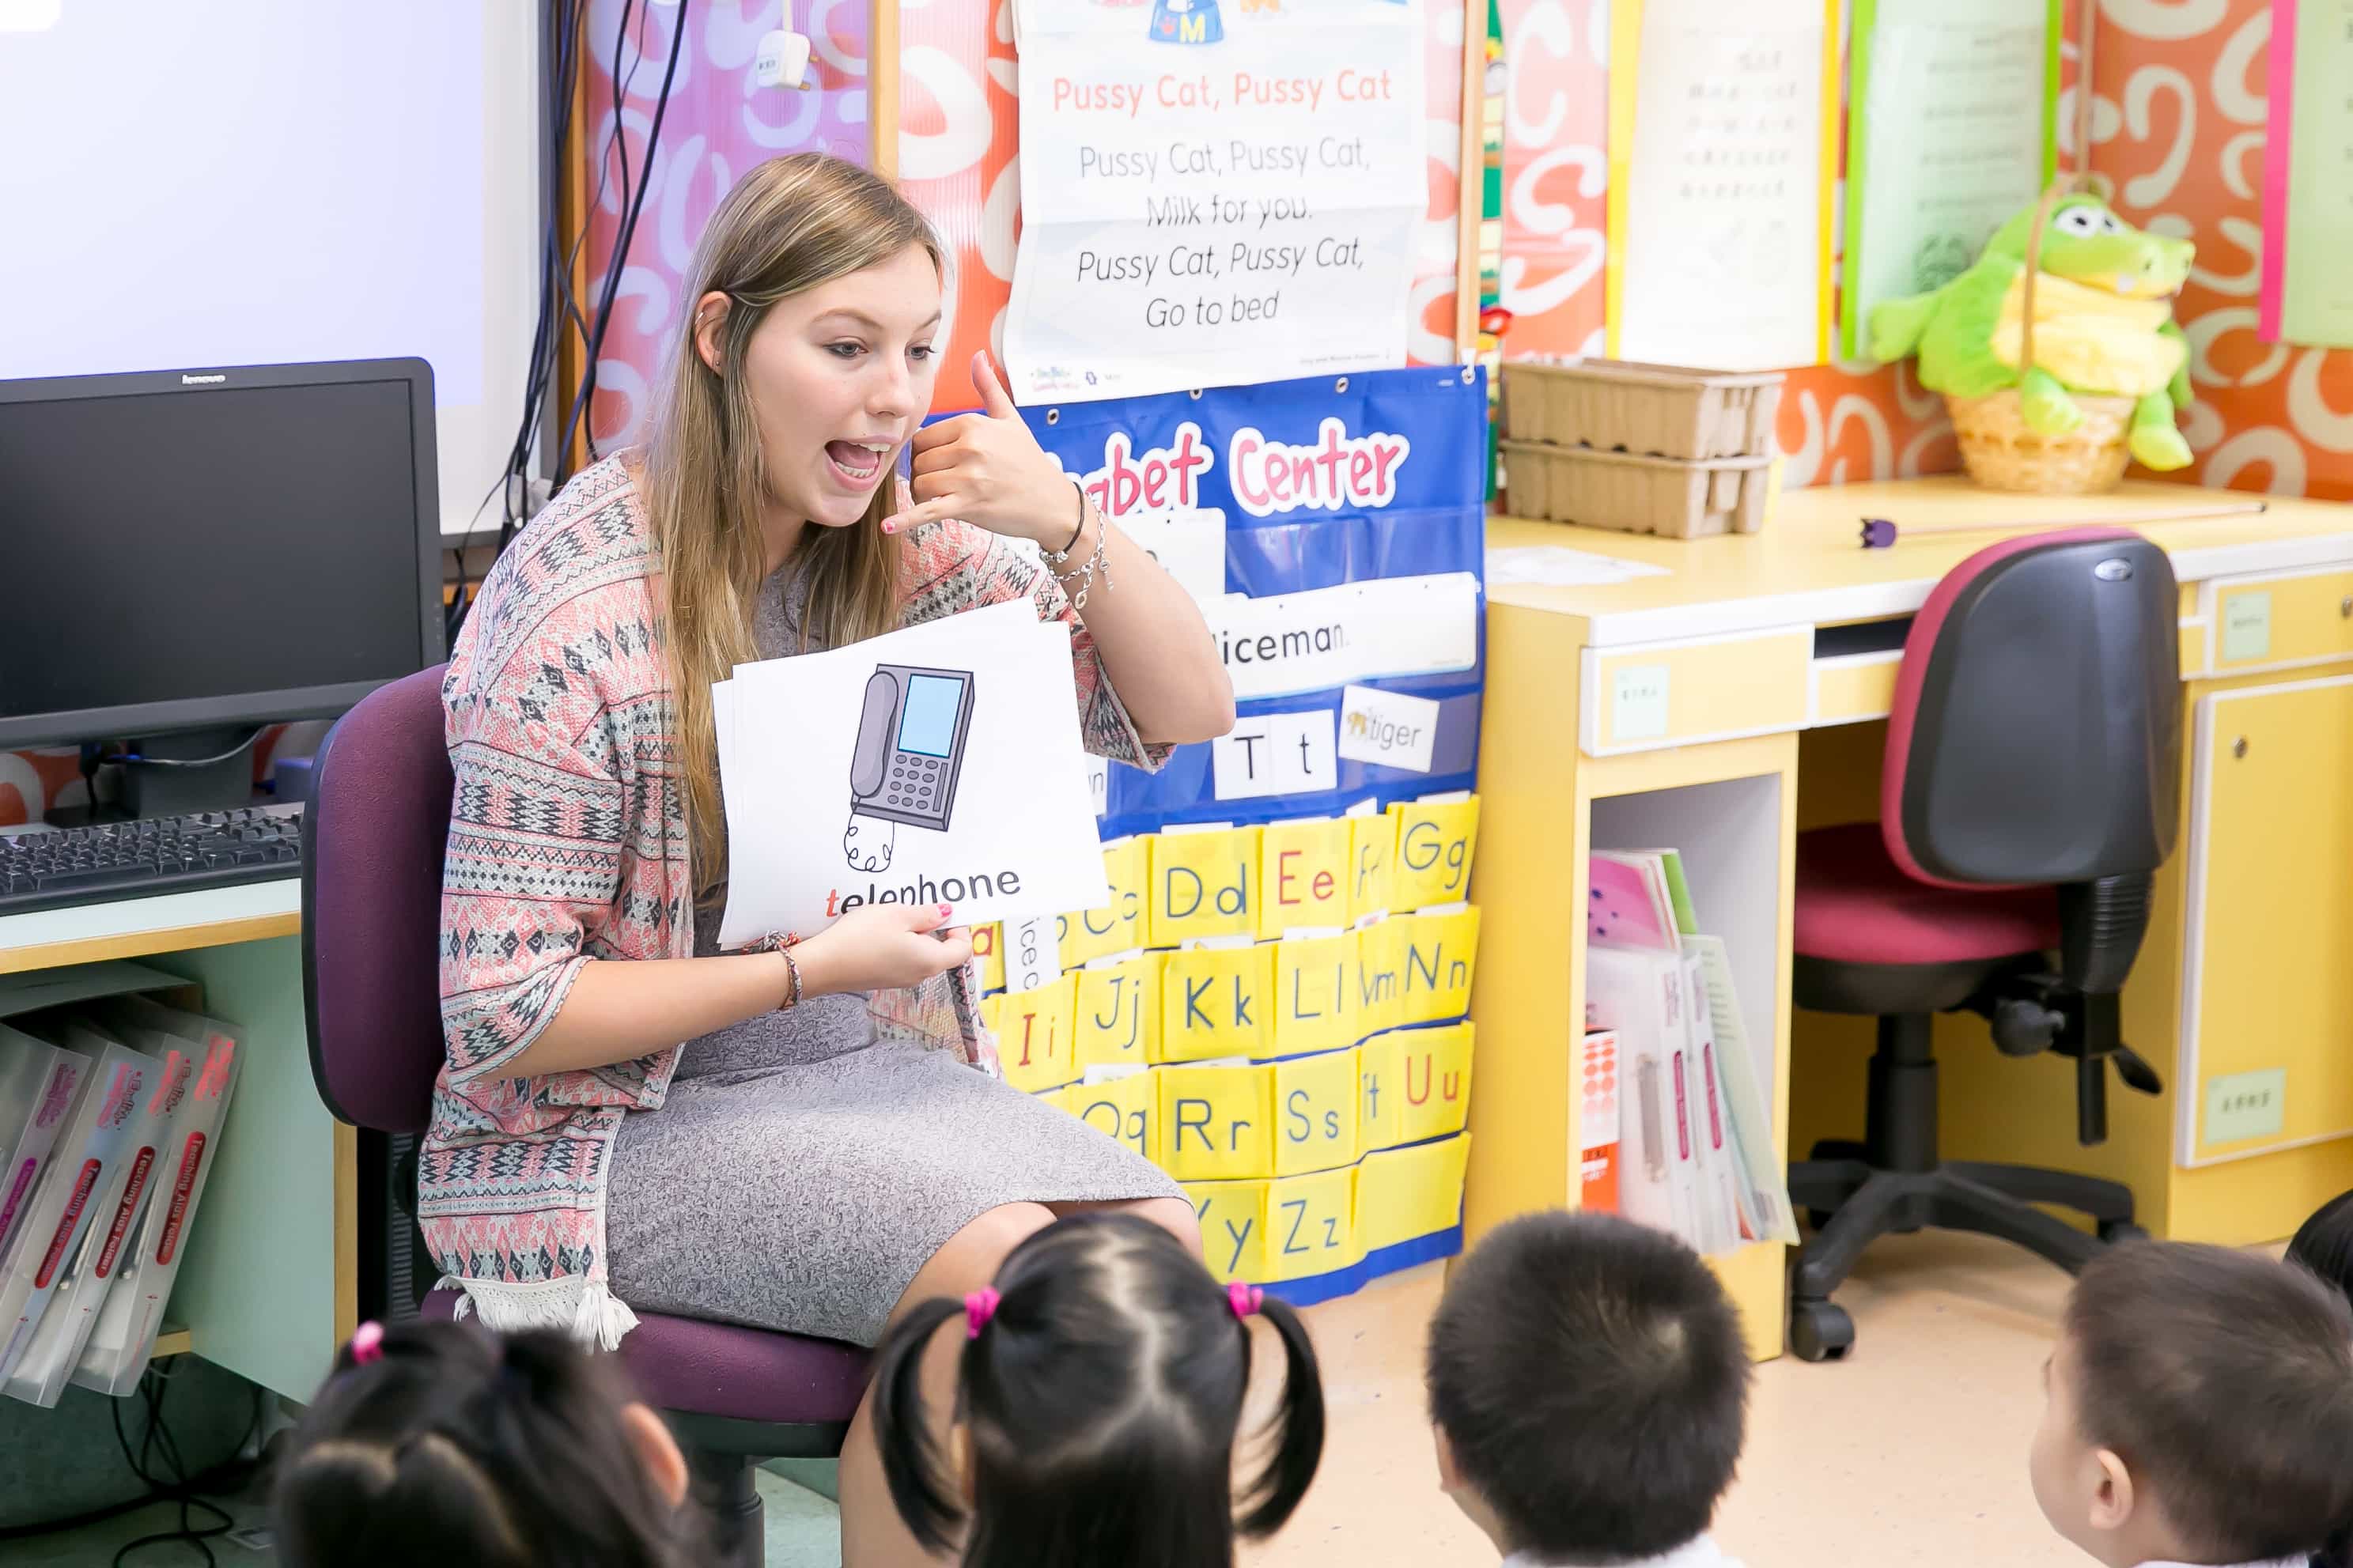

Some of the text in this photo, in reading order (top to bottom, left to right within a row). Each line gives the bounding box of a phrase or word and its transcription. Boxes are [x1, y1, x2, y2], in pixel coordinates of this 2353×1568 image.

[1179, 14, 1206, 43] M
[1054, 69, 1392, 118] Pussy Cat, Pussy Cat
[1080, 136, 1371, 183] Pussy Cat, Pussy Cat,
[1146, 194, 1313, 229] Milk for you.
[1076, 236, 1365, 286] Pussy Cat, Pussy Cat,
[1146, 290, 1280, 328] Go to bed
[1237, 428, 1400, 504] Center
[1234, 735, 1265, 780] T
[1298, 733, 1311, 775] t
